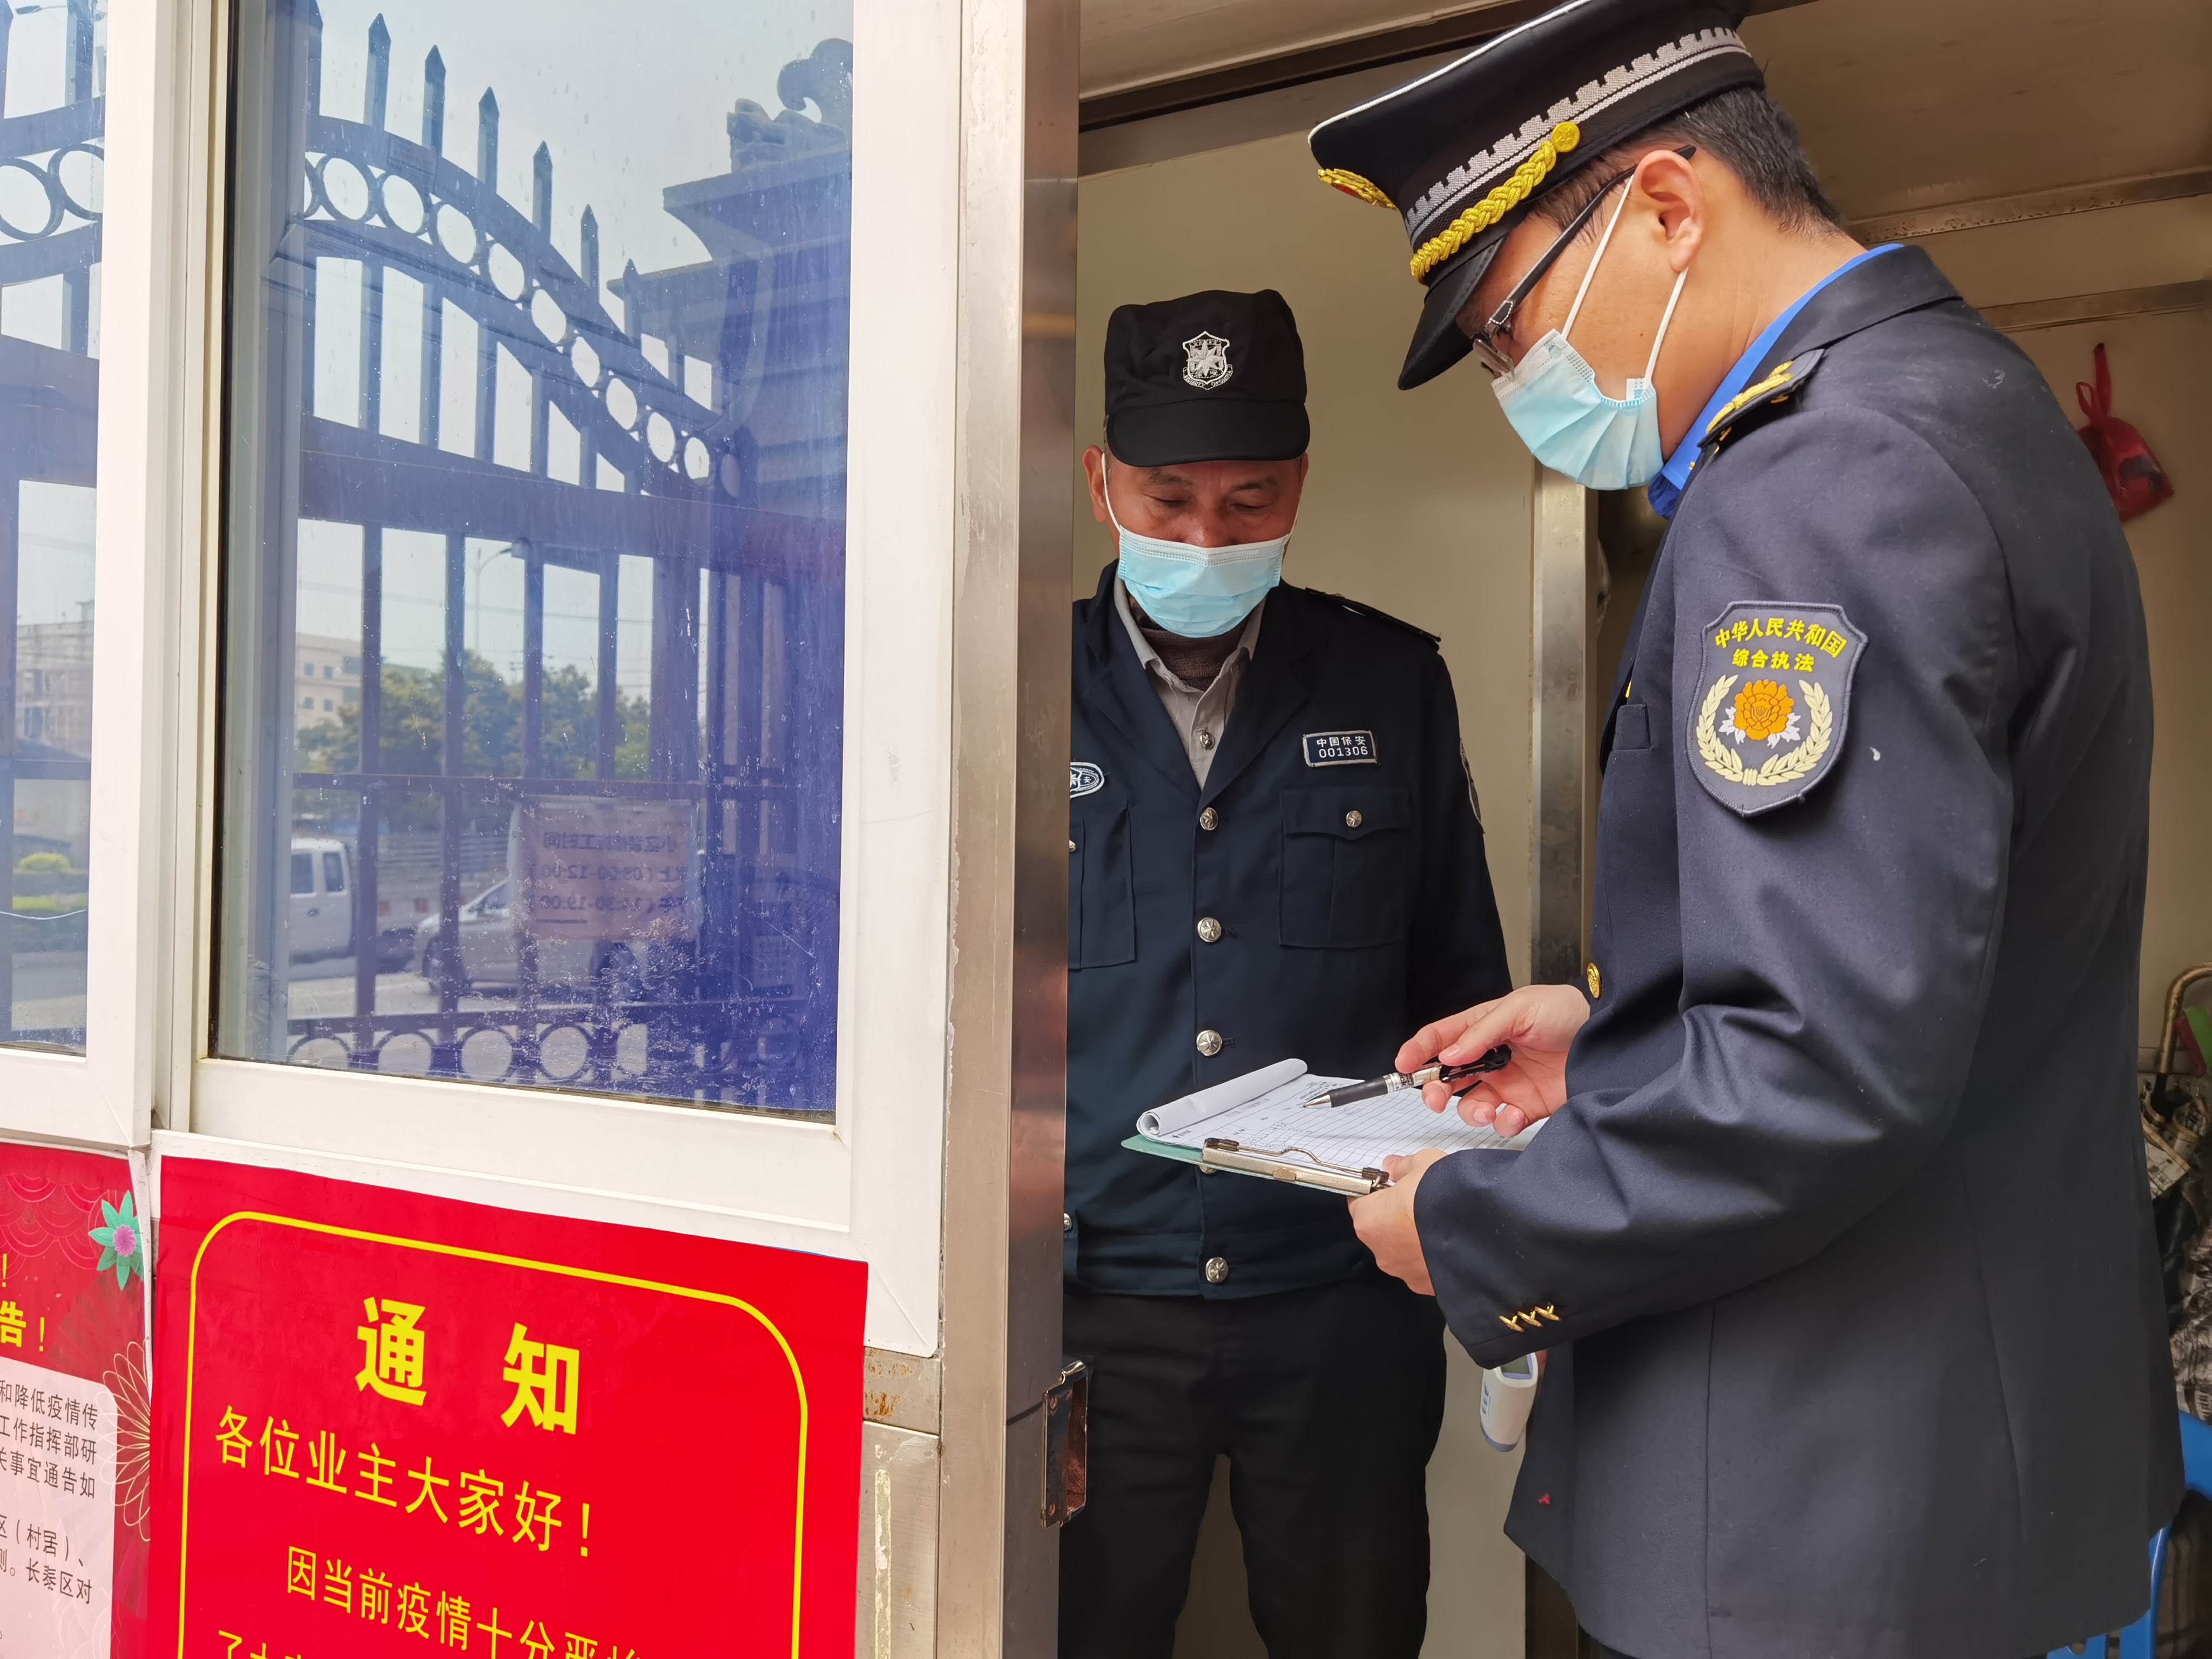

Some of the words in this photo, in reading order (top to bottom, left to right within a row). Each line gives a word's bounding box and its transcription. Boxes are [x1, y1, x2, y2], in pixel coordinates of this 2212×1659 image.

[1715, 617, 1847, 658] 中华人民共和国
[1732, 649, 1815, 672] 综合执法
[1317, 736, 1366, 747] 中国保安
[1319, 746, 1368, 758] 001306
[355, 1296, 580, 1435] 通知
[0, 1380, 98, 1431] 和降低疫情传
[0, 1415, 97, 1465] 工作指挥部研
[215, 1405, 590, 1557] 各位业主大家好！
[287, 1546, 640, 1659] 因当前疫情十分严
